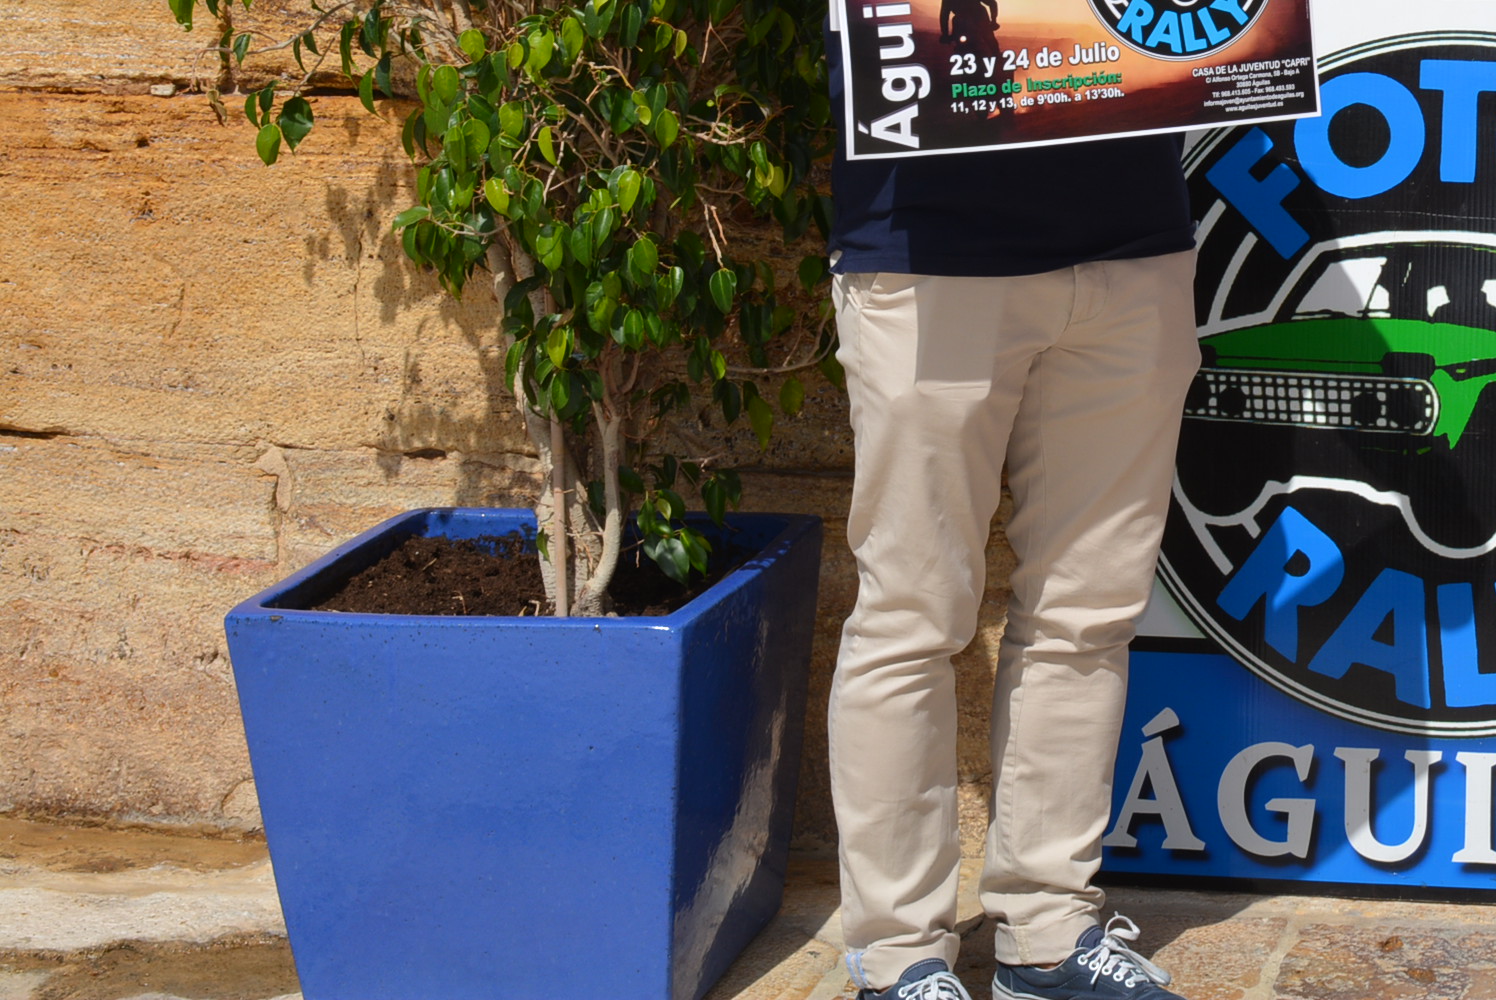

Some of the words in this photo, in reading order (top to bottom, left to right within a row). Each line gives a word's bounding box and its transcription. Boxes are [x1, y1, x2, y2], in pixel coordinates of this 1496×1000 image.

[949, 53, 978, 76] 23
[983, 56, 997, 78] y
[1002, 48, 1030, 71] 24
[1035, 47, 1063, 69] de
[1068, 42, 1121, 66] Julio
[1192, 67, 1215, 78] CASA
[1215, 65, 1227, 75] DE
[1227, 64, 1238, 74] LA
[1239, 60, 1281, 73] JUVENTUD
[1281, 57, 1311, 68] "CAPRI"
[951, 82, 997, 99] Plazo
[1001, 79, 1022, 94] de
[1027, 70, 1123, 91] Inscripción:
[1212, 75, 1231, 83] Alfonso
[1231, 73, 1249, 82] Ortega
[1249, 71, 1273, 80] Carmona,
[1284, 68, 1295, 77] Bajo
[1252, 79, 1271, 88] Águilas
[950, 101, 970, 114] 11,
[971, 99, 987, 112] 12
[989, 101, 997, 115] y
[999, 98, 1018, 110] 13,
[1020, 95, 1035, 107] de
[1036, 92, 1072, 105] 9'00h.
[1074, 94, 1082, 102] a
[1084, 87, 1125, 101] 13'30h.
